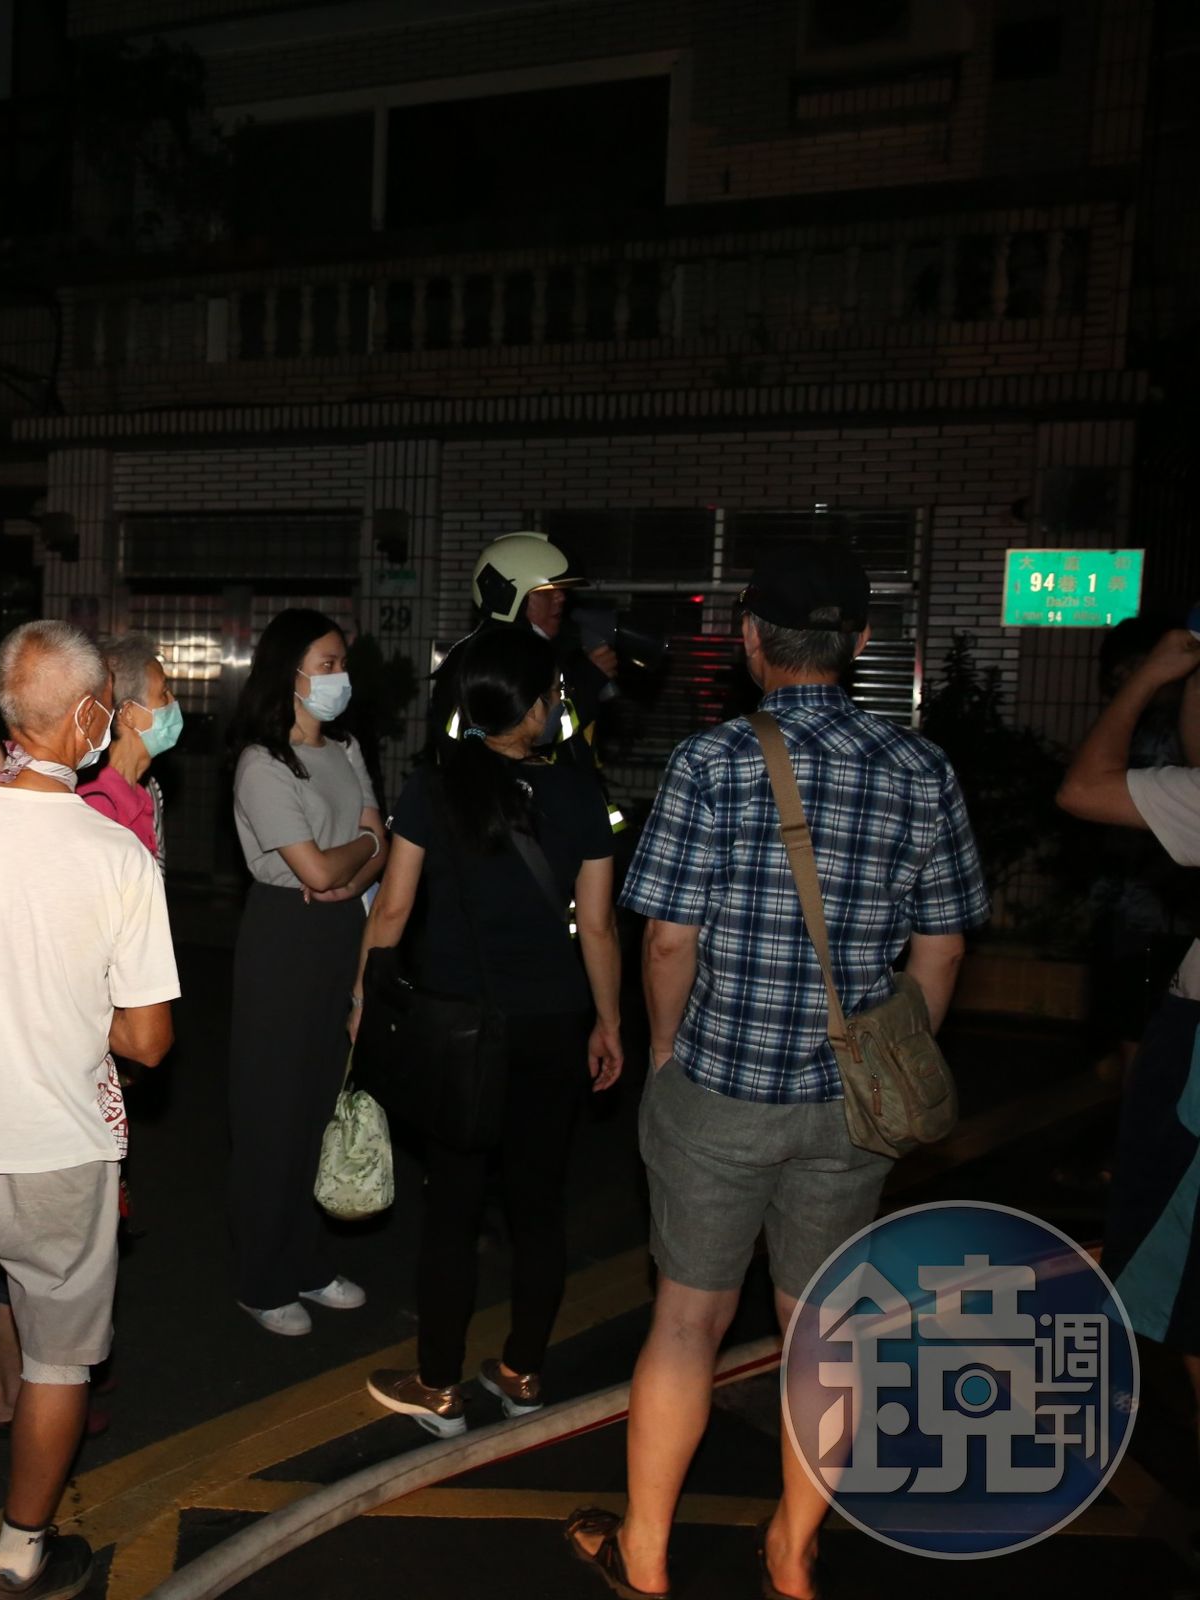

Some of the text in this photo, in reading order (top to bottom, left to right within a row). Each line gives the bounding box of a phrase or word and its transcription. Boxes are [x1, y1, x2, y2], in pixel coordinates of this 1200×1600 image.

[380, 605, 412, 631] 29
[1047, 610, 1063, 622] 94
[1105, 612, 1113, 624] 1
